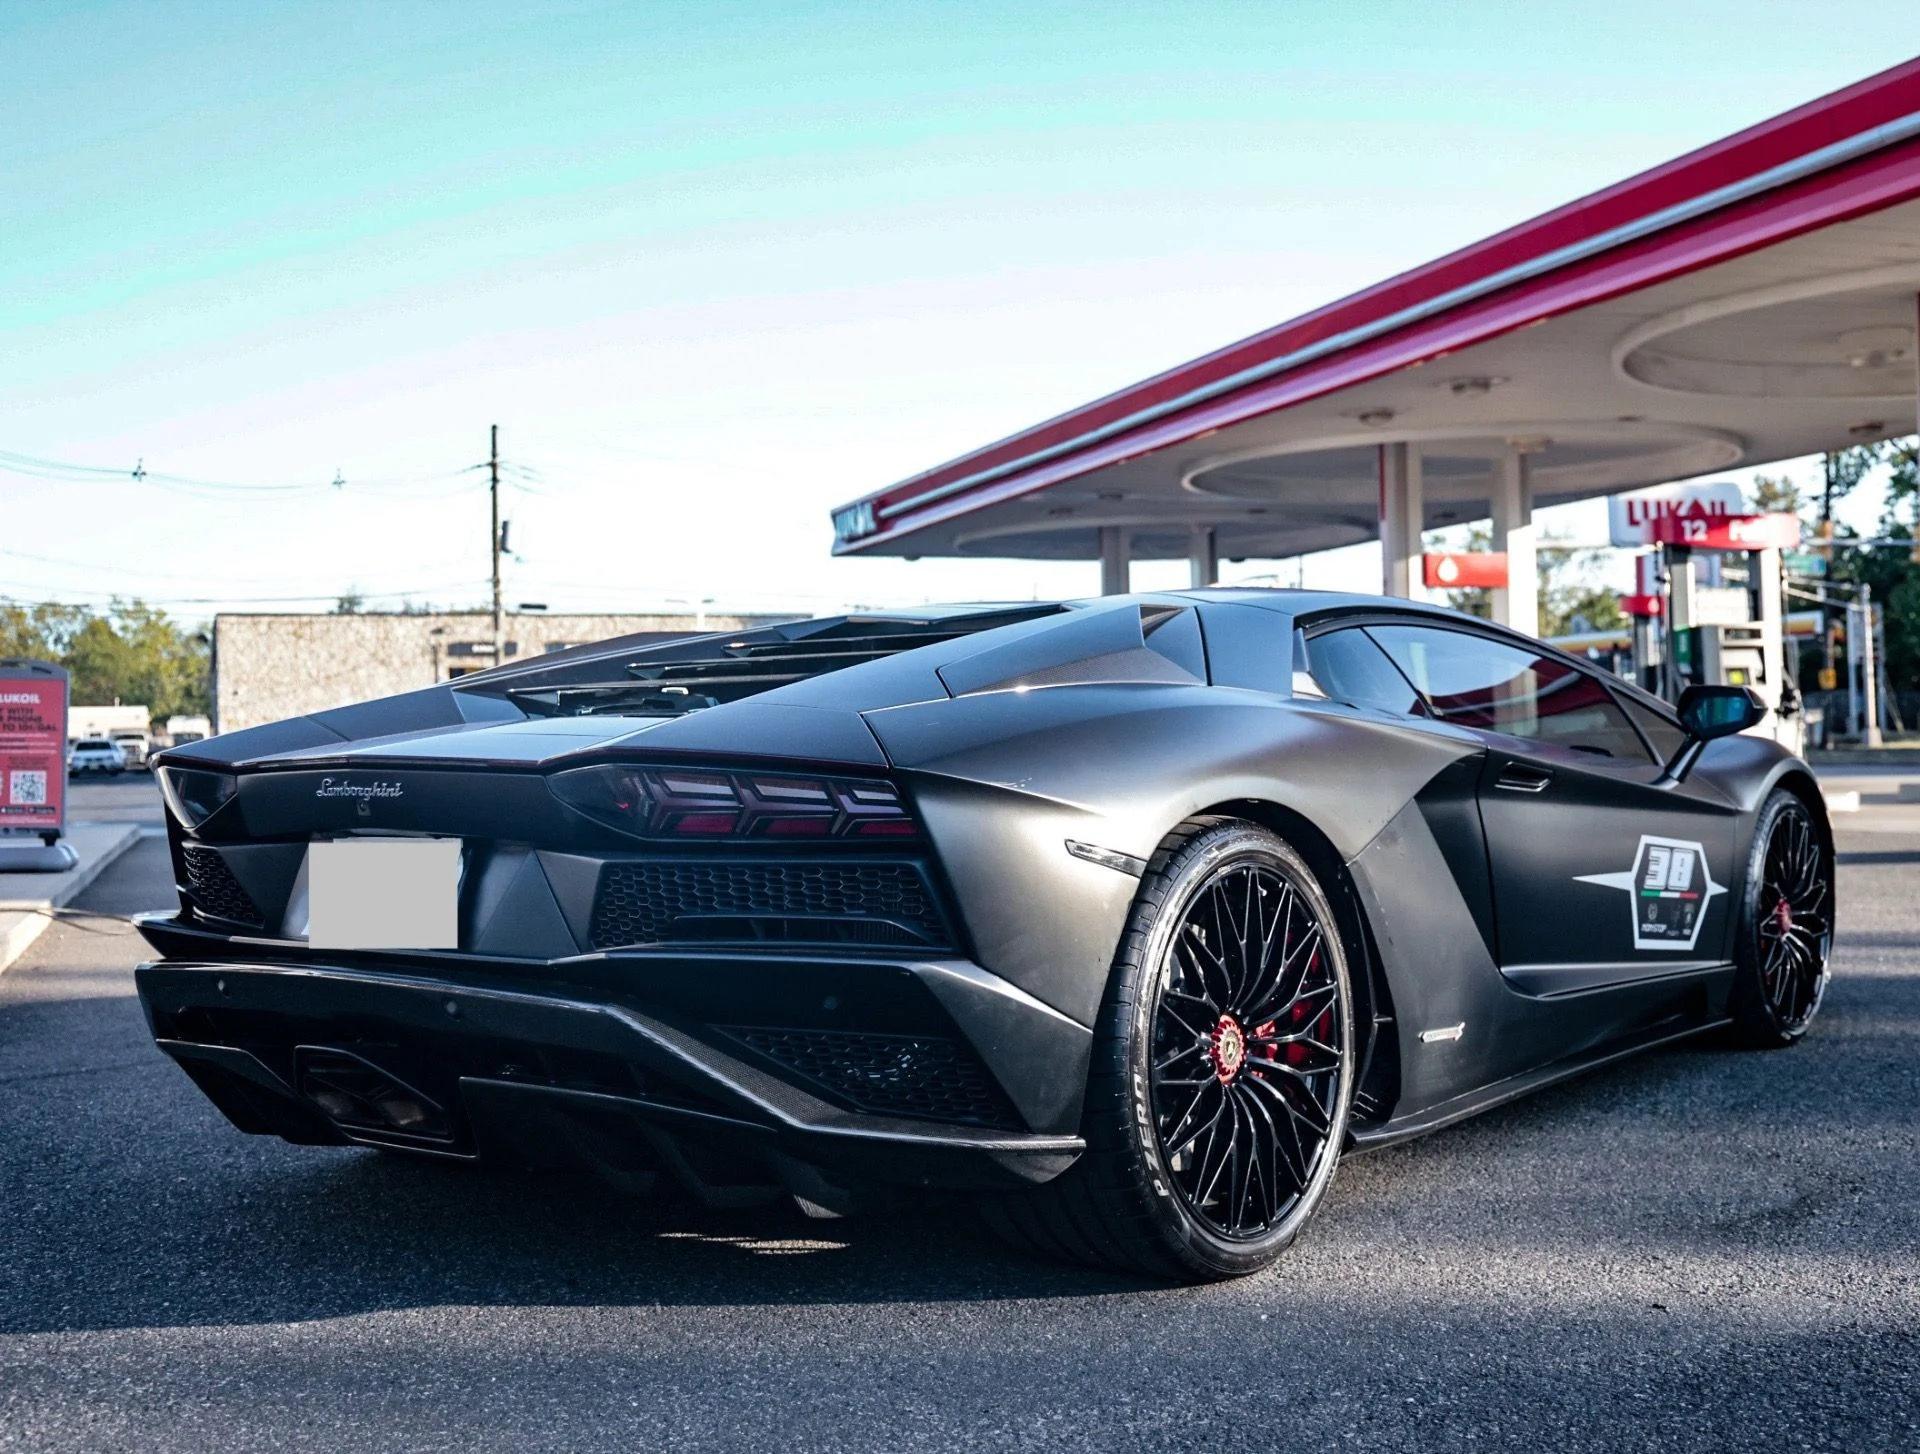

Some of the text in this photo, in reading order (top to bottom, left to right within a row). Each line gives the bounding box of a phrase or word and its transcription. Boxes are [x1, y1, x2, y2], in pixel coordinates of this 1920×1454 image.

[1682, 519, 1708, 541] 12
[316, 778, 404, 801] Lamborghini
[1133, 1073, 1170, 1197] P ZERO
